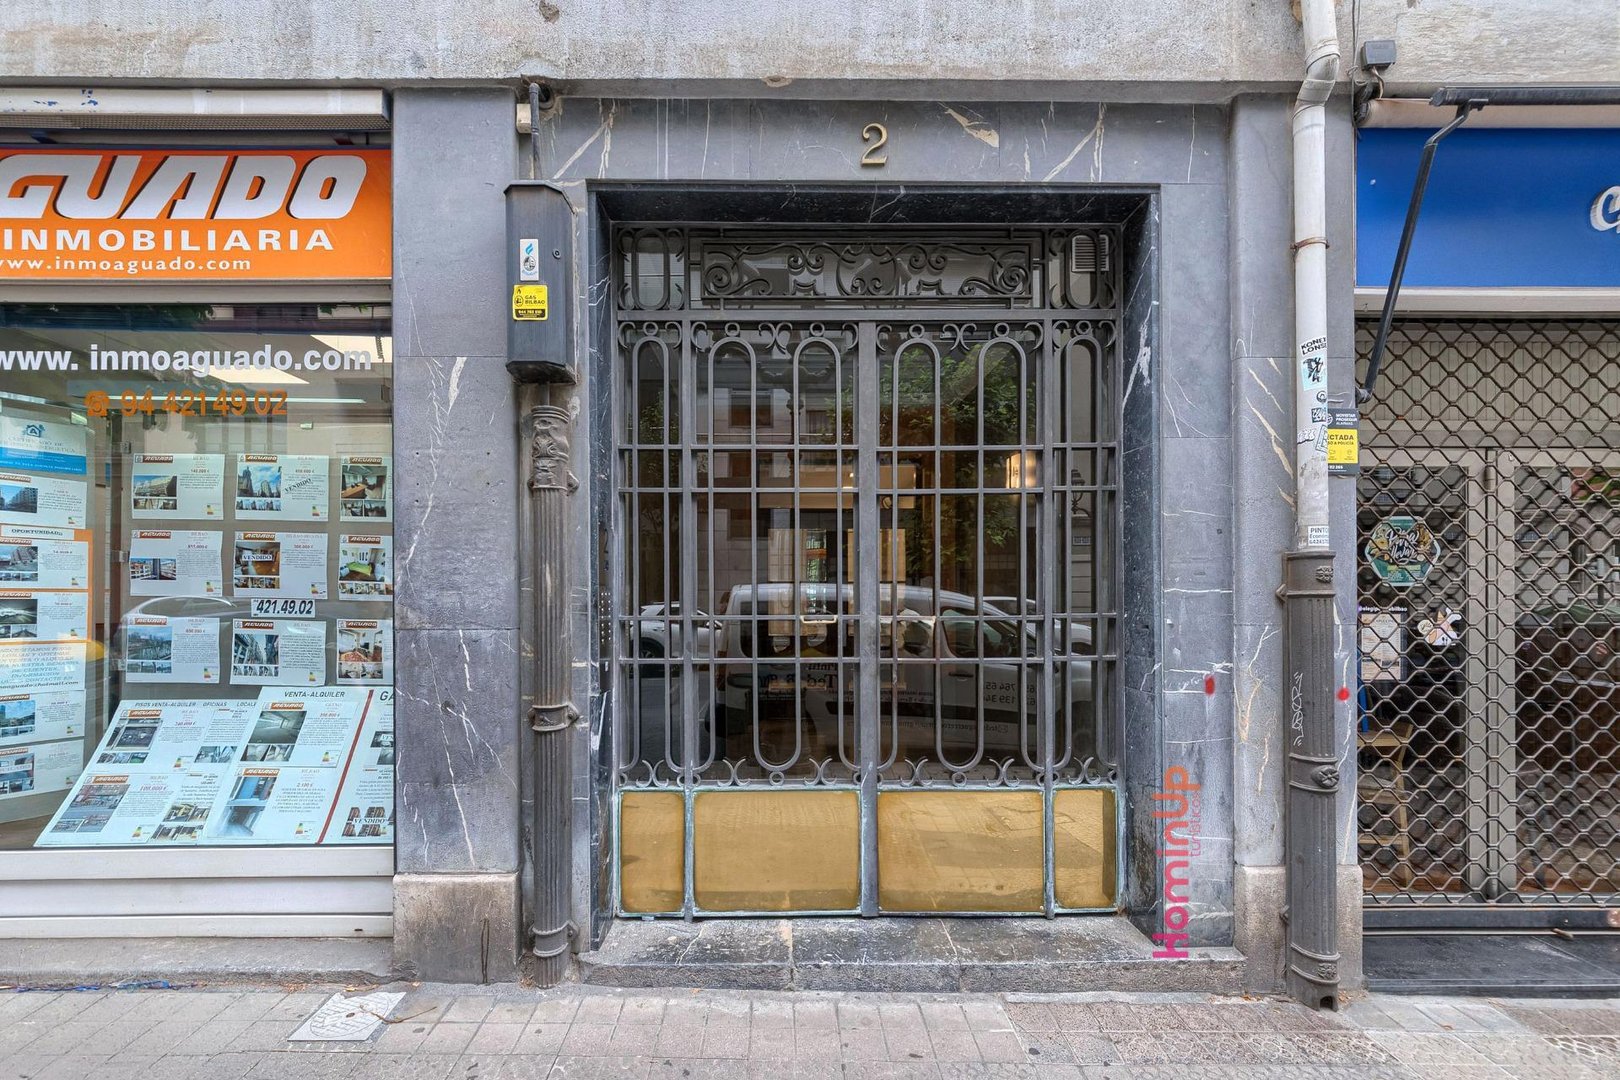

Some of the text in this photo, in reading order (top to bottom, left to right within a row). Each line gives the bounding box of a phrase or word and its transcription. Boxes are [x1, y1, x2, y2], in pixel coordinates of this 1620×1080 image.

[862, 123, 888, 165] 2
[0, 154, 367, 219] GUADO
[4, 229, 334, 252] INMOBILIARIA
[90, 344, 371, 378] inmoaguado.com
[121, 388, 288, 417] 94 421 49 02
[284, 478, 313, 493] VENDIDO
[256, 600, 313, 614] 421.49.02
